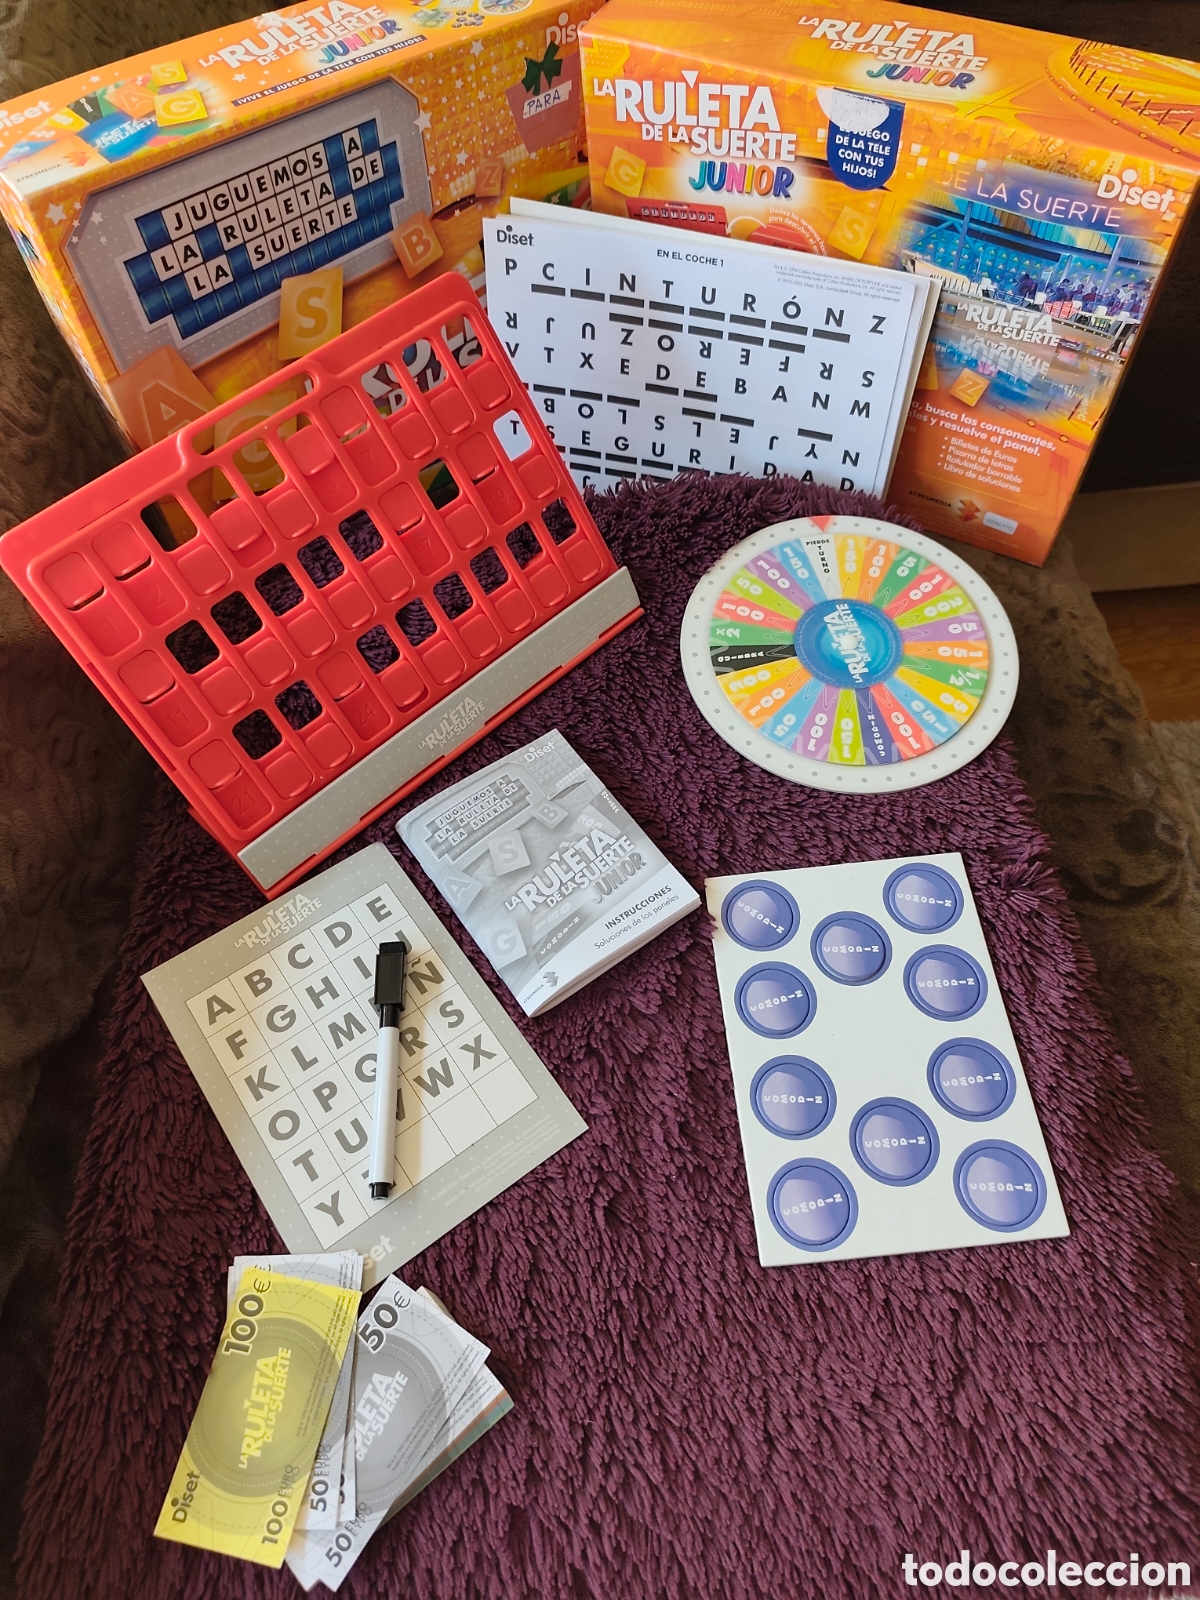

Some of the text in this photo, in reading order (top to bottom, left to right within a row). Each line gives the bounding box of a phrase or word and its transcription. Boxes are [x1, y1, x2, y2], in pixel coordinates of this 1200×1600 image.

[198, 0, 363, 69] LA RULETA
[256, 5, 387, 67] DE LA SUERTE
[319, 19, 402, 64] JUNIOR
[797, 16, 975, 57] LA RULETA
[263, 87, 276, 97] EL
[276, 77, 307, 93] JUEGO
[334, 59, 356, 72] TELE
[354, 52, 376, 66] CON
[374, 45, 394, 57] TUS
[393, 35, 424, 50] HIJOS!
[829, 40, 989, 72] DE LA SUERTE
[866, 62, 975, 90] JUNIOR
[527, 89, 561, 115] PARA
[593, 77, 781, 132] LA RULETA
[641, 124, 798, 162] DE LA SUERTE
[835, 134, 891, 156] DE LA TELE
[838, 148, 884, 168] CON TUS
[174, 136, 361, 232] JUGUEMOS A
[688, 160, 795, 200] JUNIOR
[842, 161, 877, 179] HIJOS!
[976, 177, 1126, 228] LA SUERTE
[1096, 168, 1175, 212] Diset
[161, 159, 381, 273] LA RULETA DE
[194, 201, 353, 292] LA SUERTE
[496, 224, 535, 247] Diset
[656, 249, 719, 267] EN EL COCHE
[957, 302, 1053, 334] LA RULETA
[976, 323, 1061, 347] DE SUERTE
[509, 419, 520, 435] T
[925, 402, 958, 421] busca
[960, 413, 978, 426] las
[979, 420, 1057, 452] consonantes,
[939, 419, 1041, 457] resuelve el panel.
[948, 445, 1014, 472] Pizarra de letras
[950, 437, 1018, 464] Billetes de Euros
[943, 463, 1022, 493] Libro de soluciones
[945, 454, 1023, 484] Rotulador borrable
[908, 490, 952, 509] ATRESMEDIA
[805, 538, 830, 546] PIERDE
[757, 559, 791, 589] 100
[868, 544, 887, 578] 100
[896, 556, 918, 577] 50
[736, 577, 763, 596] 50
[908, 574, 943, 601] 100
[722, 602, 765, 620] 100
[923, 596, 964, 617] 200
[948, 622, 978, 634] 50
[937, 646, 983, 658] 150
[729, 669, 771, 692] 200
[453, 700, 486, 736] SUERTE
[749, 687, 786, 717] 100
[939, 692, 969, 714] 50
[424, 696, 478, 750] RULETA
[807, 712, 828, 752] 100
[891, 711, 921, 750] 100
[524, 741, 556, 763] Diset
[438, 780, 505, 826] JUGUEMOS A
[438, 783, 518, 841] LA RULETA DE
[451, 799, 512, 844] LA SUERTE
[504, 828, 615, 912] LA RULETA
[546, 835, 636, 908] DE LA SUERTE
[592, 852, 647, 904] JUNIOR
[604, 884, 673, 930] INSTRUCCIONES
[737, 901, 785, 934] COMODIN
[897, 892, 952, 908] COMODIN
[242, 892, 313, 950] RULETA
[259, 896, 324, 948] DE SUERTE
[594, 894, 680, 950] Soluciones de los paneles
[206, 895, 393, 1026] A B C D E
[823, 945, 880, 954] COMODIN
[918, 977, 975, 988] COMODIN
[225, 955, 374, 1061] F G H I
[749, 989, 804, 1012] COMODIN
[243, 1011, 367, 1102] K L M
[268, 1000, 466, 1141] O P R S
[942, 1071, 1002, 1087] COMODIN
[292, 1033, 498, 1183] T U W X
[763, 1095, 823, 1105] COMODIN
[865, 1135, 926, 1148] COMODIN
[783, 1193, 843, 1216] COMODIN
[970, 1182, 1033, 1192] COMODIN
[313, 1190, 345, 1228] Y
[238, 1354, 279, 1468] LA RULETA
[264, 1346, 292, 1443] DE SUERTE
[370, 1370, 409, 1435] SUERTE
[171, 1470, 200, 1525] Diset
[310, 1478, 330, 1513] 50
[261, 1499, 290, 1546] 100
[325, 1532, 353, 1569] 50
